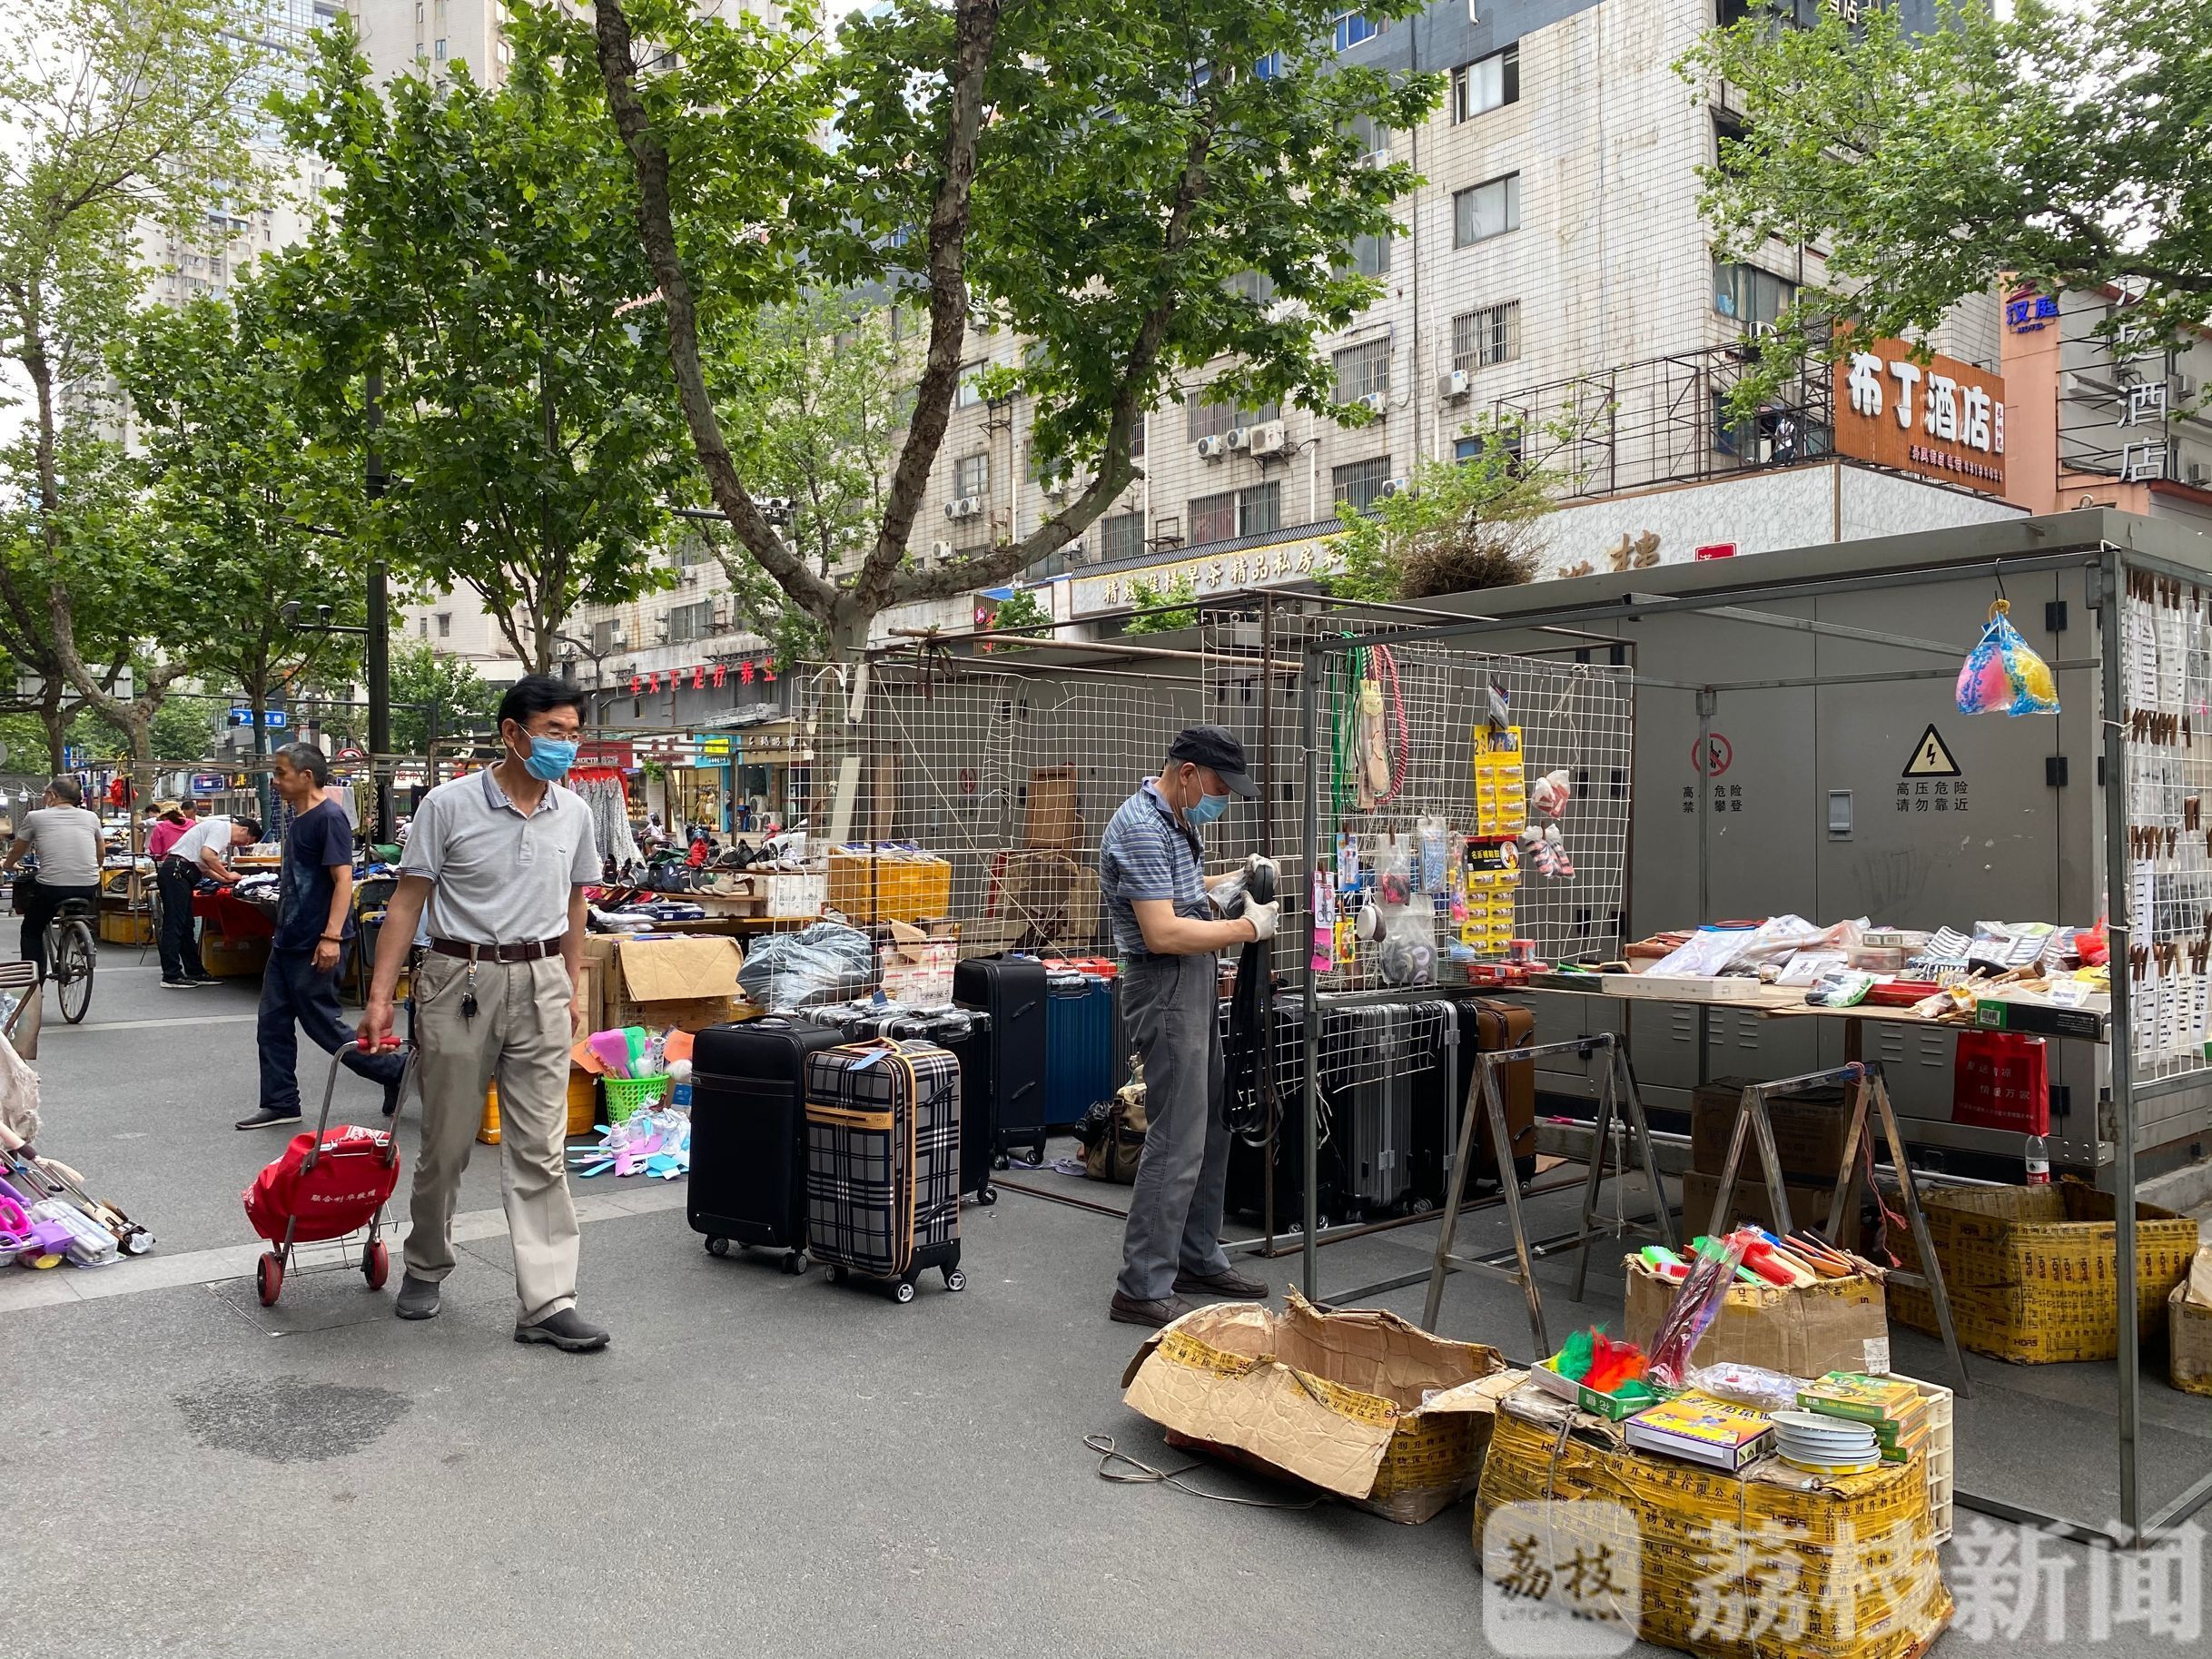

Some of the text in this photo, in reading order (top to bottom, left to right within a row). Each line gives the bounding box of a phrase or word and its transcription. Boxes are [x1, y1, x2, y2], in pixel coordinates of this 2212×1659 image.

[2006, 295, 2059, 326] 汉庭
[2016, 321, 2046, 334] HOTEL
[1847, 351, 1991, 453] 布丁酒店
[1683, 785, 1743, 797] 高危险
[1896, 781, 1969, 795] 高压危险
[1683, 799, 1743, 813] 禁攀登
[1896, 797, 1969, 812] 请勿靠近
